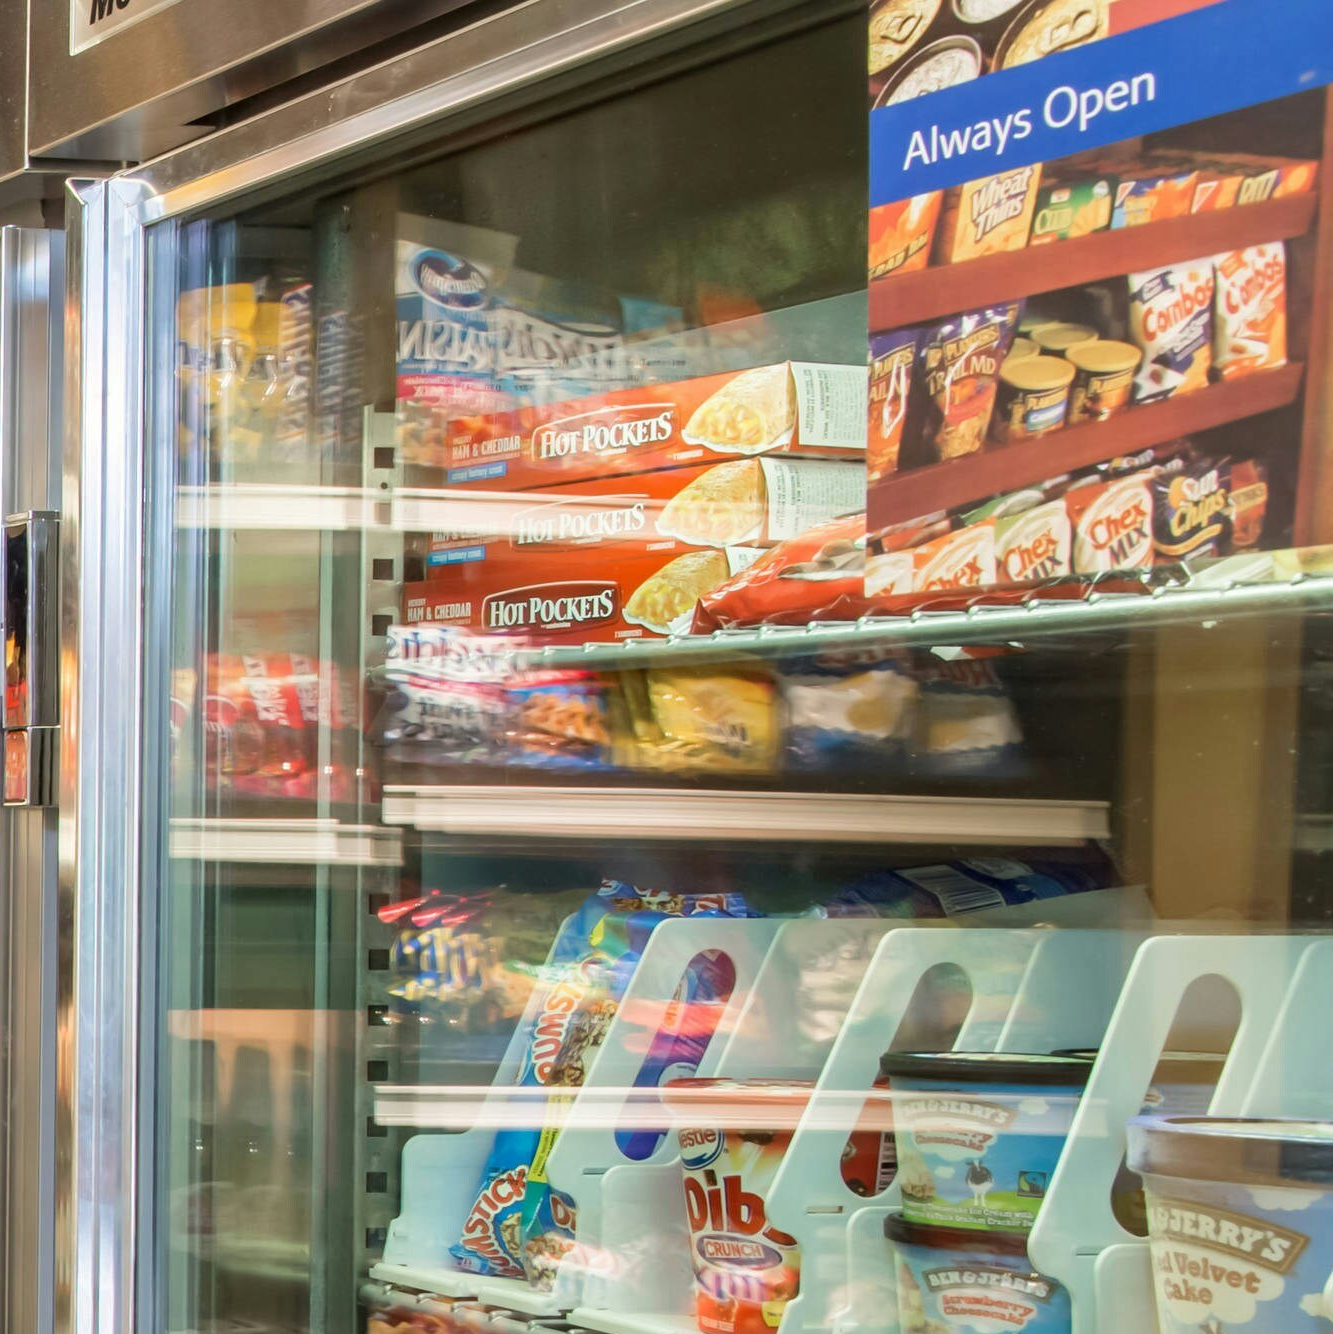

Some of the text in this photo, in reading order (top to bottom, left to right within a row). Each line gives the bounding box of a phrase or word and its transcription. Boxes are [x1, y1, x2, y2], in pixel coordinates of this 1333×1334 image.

[902, 72, 1157, 170] Always Open
[452, 434, 521, 460] HAM & CHEDDAR
[540, 411, 673, 458] HOT POCKETS
[407, 602, 471, 622] HAM & CHEDDAR
[489, 590, 614, 627] HOT POCKETS
[704, 1240, 764, 1259] CRUNCH
[1176, 1251, 1261, 1294] Velvet
